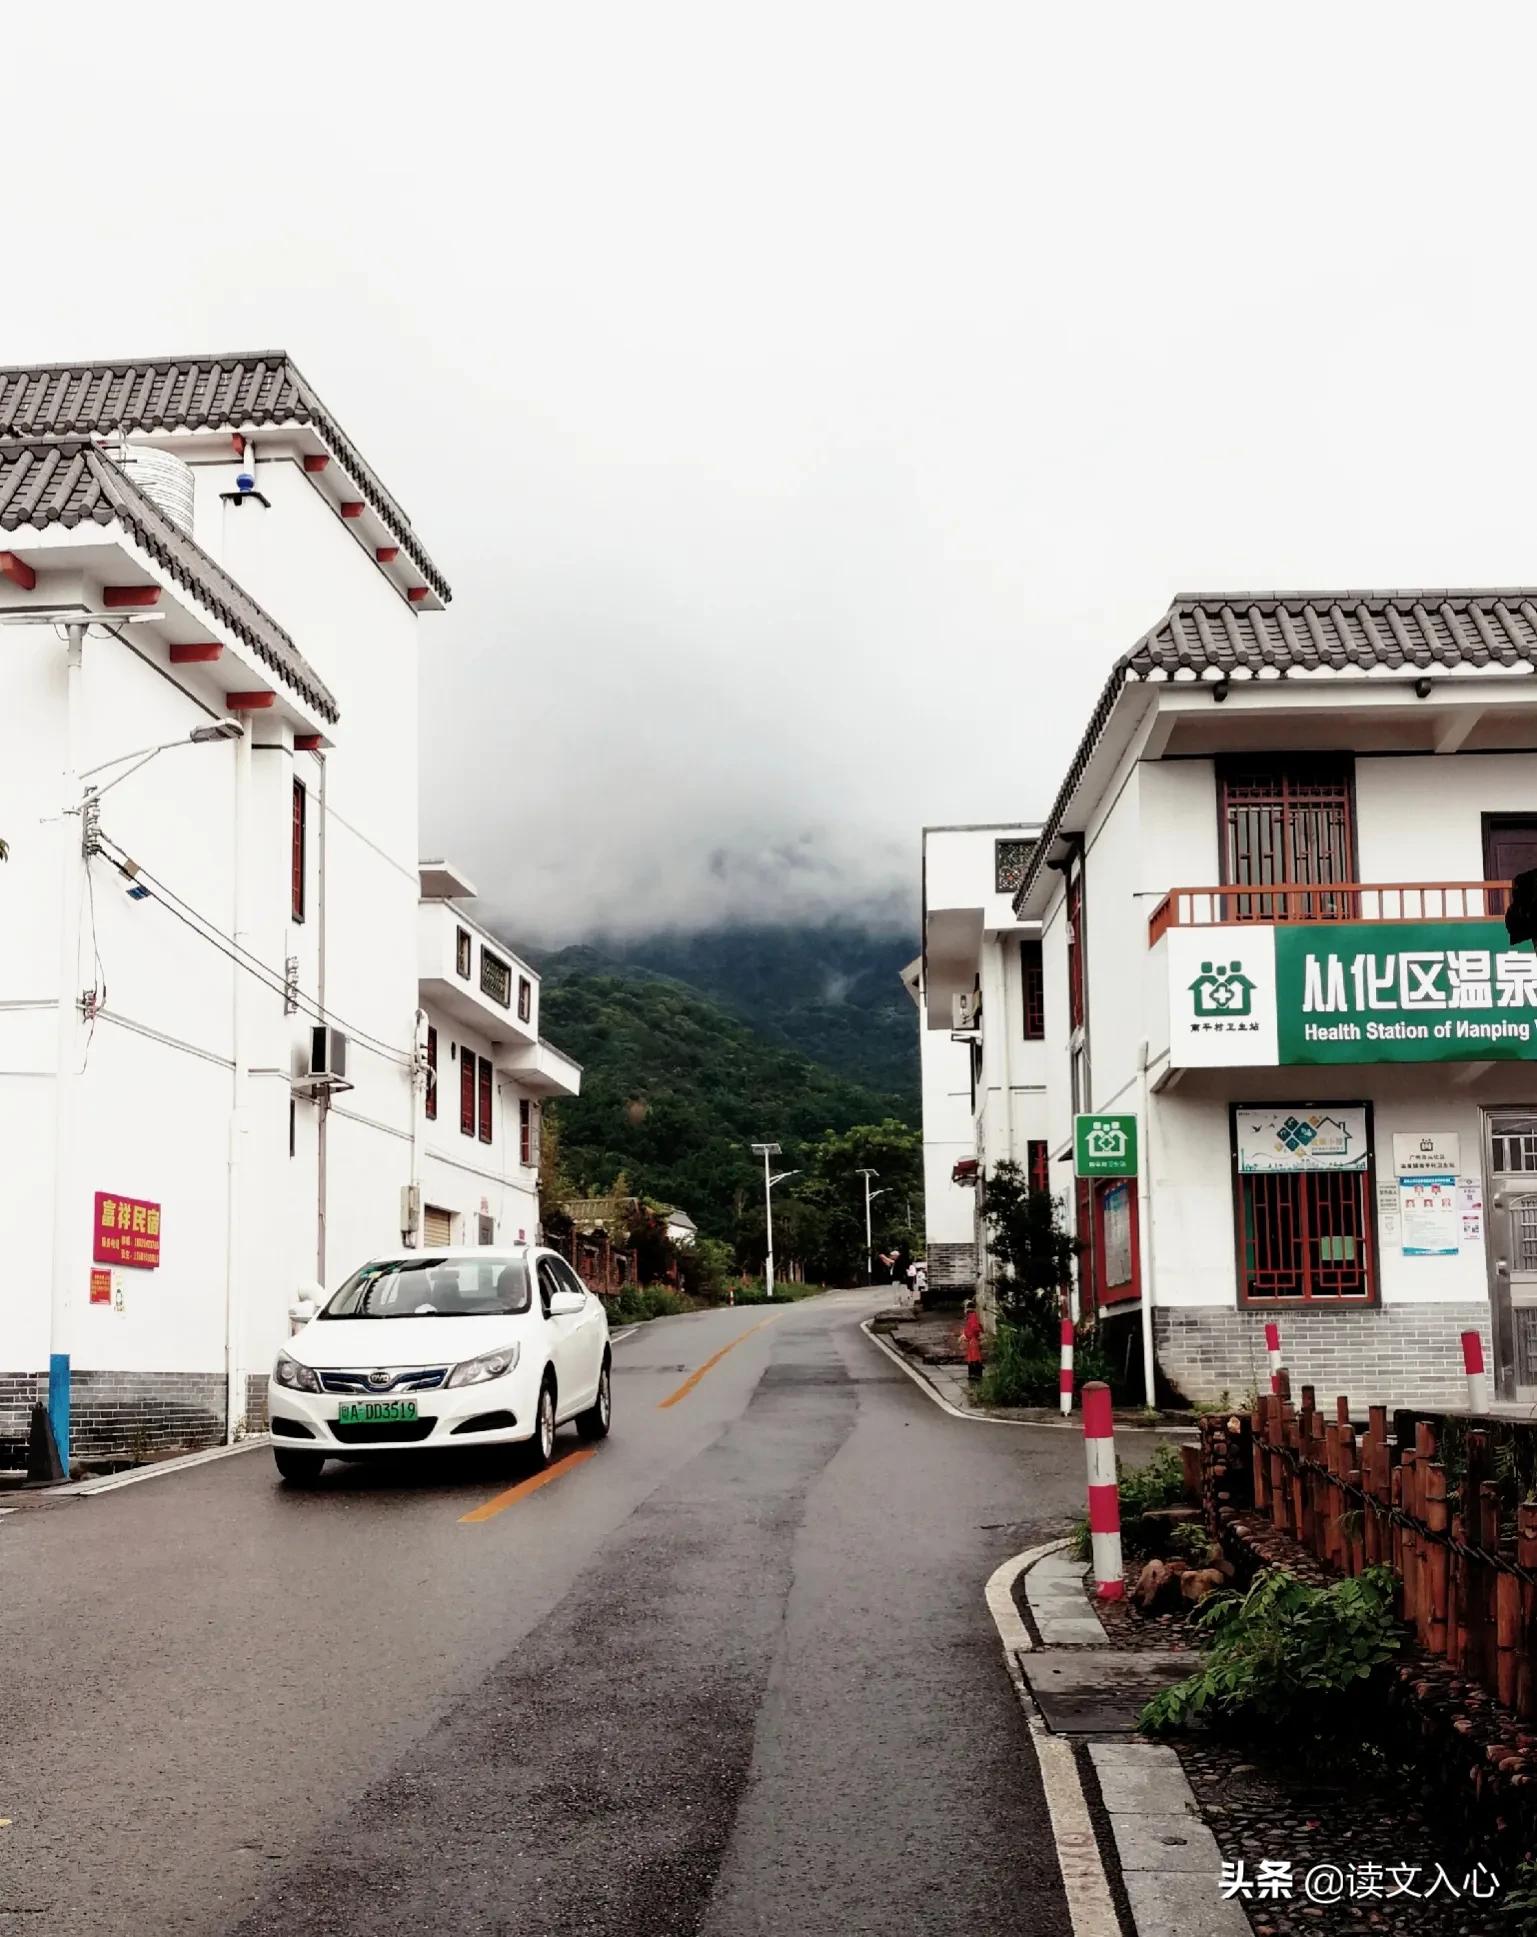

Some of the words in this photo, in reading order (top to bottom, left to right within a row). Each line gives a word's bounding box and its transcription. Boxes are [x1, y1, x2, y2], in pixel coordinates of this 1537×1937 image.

[1303, 950, 1537, 1012] 从化区温泉
[1190, 1021, 1260, 1033] 南平村卫生站
[1305, 1023, 1361, 1041] Health
[1366, 1021, 1429, 1040] Station
[1434, 1021, 1453, 1038] of
[101, 1199, 160, 1236] 富祥民宿
